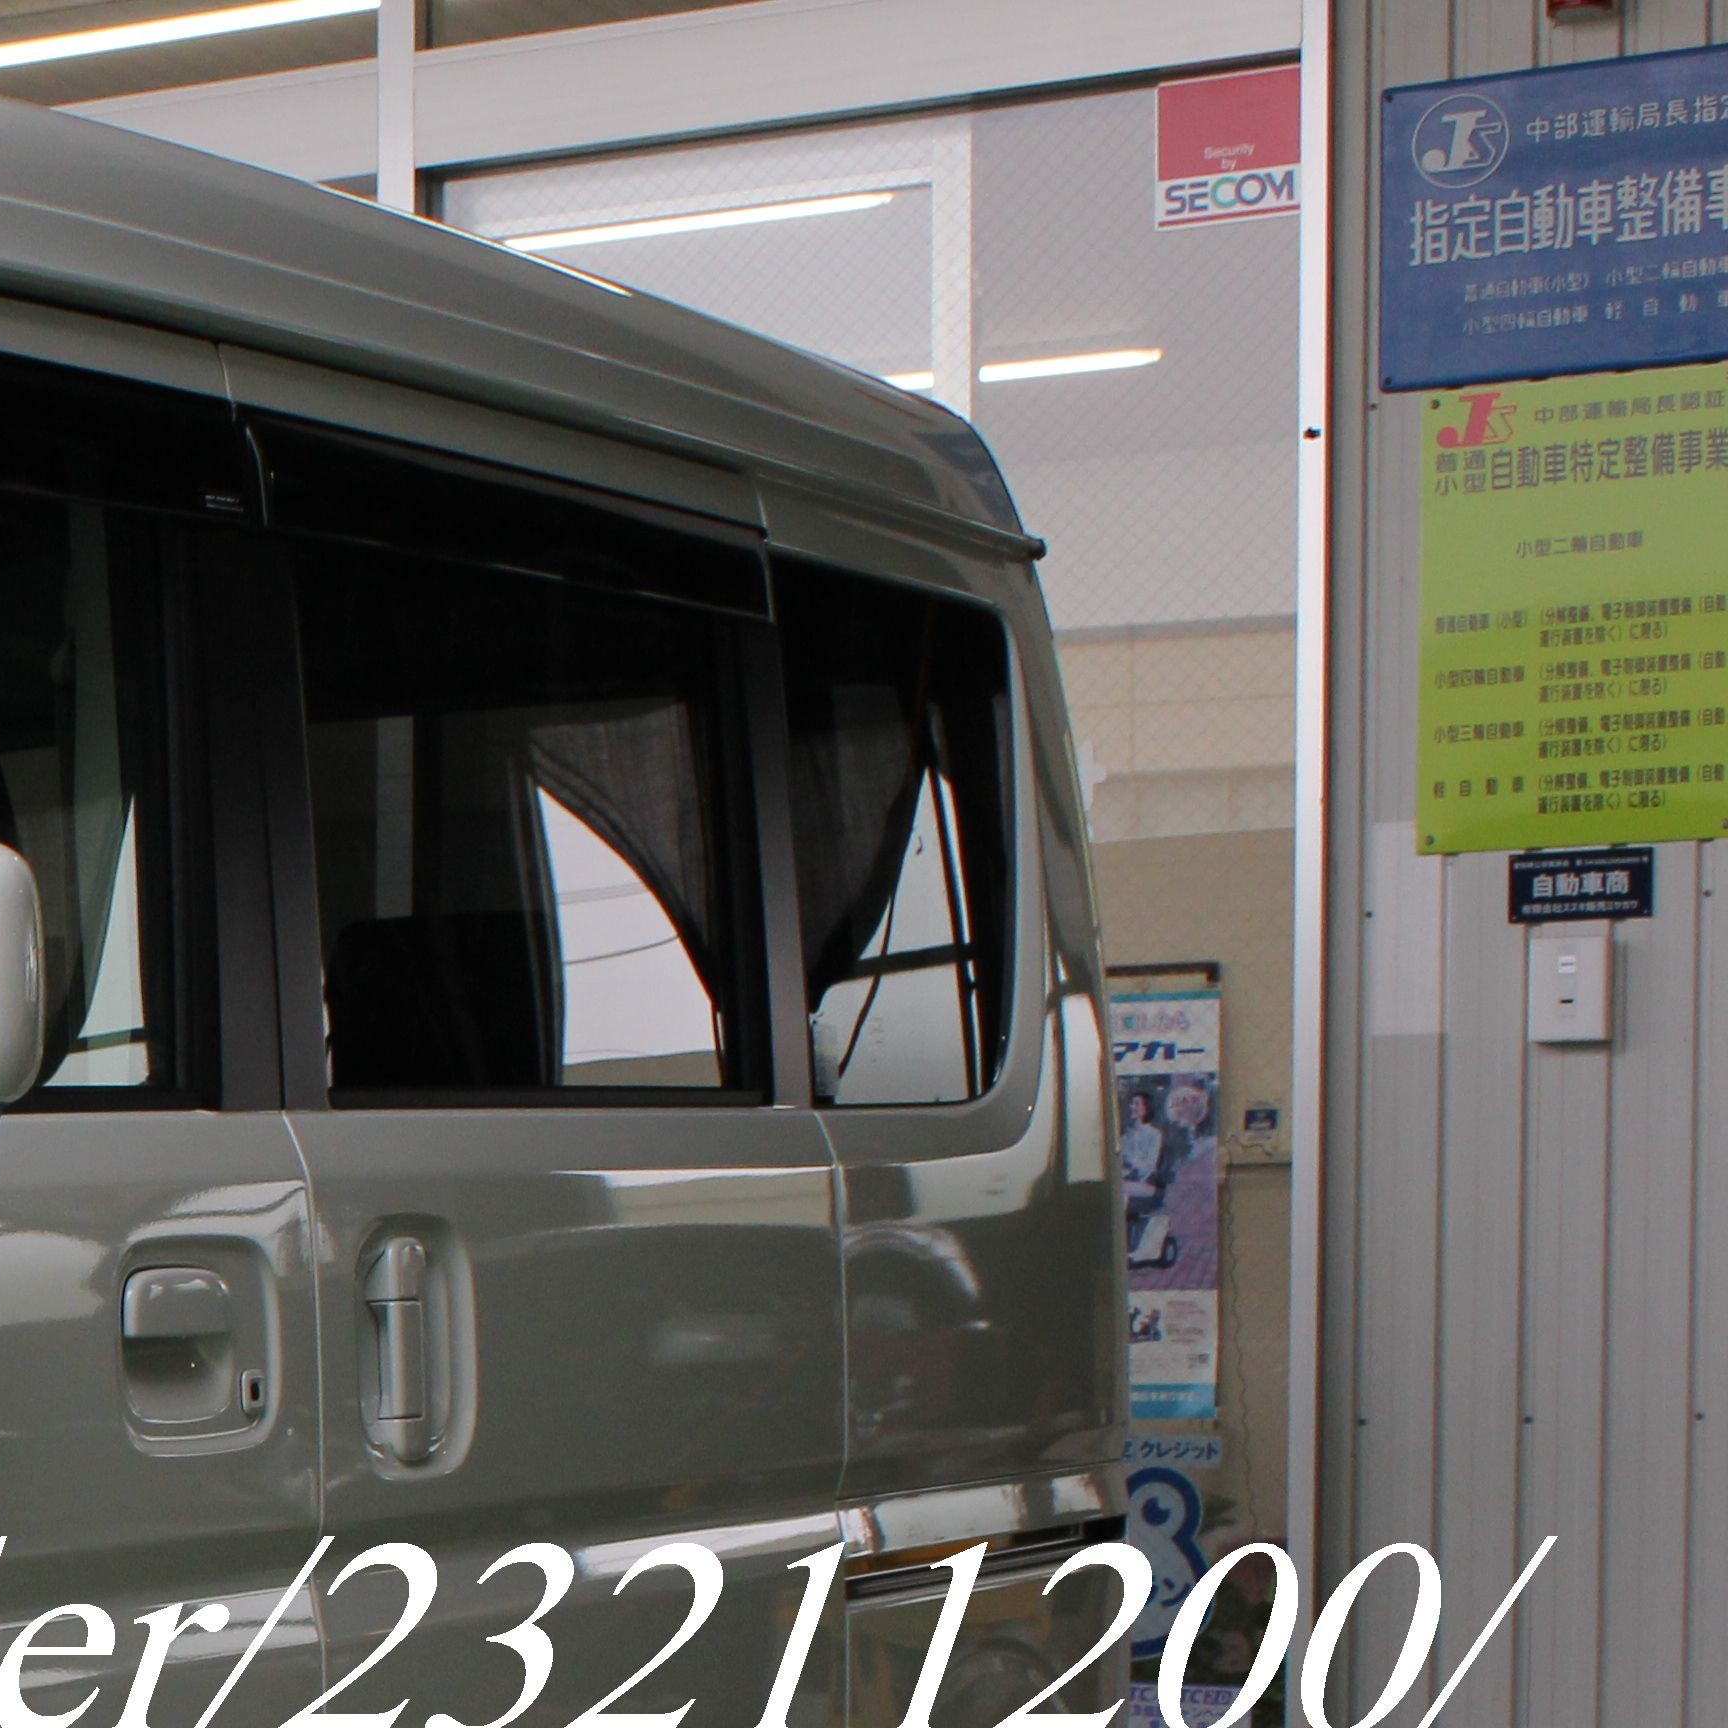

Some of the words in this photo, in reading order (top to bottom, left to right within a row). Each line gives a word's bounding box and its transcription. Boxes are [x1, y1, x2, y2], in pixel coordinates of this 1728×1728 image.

[1203, 143, 1256, 160] Security
[1220, 158, 1237, 171] by
[1164, 169, 1295, 217] SECOM
[1532, 870, 1630, 898] 自動車商
[1140, 1440, 1220, 1461] クレジット
